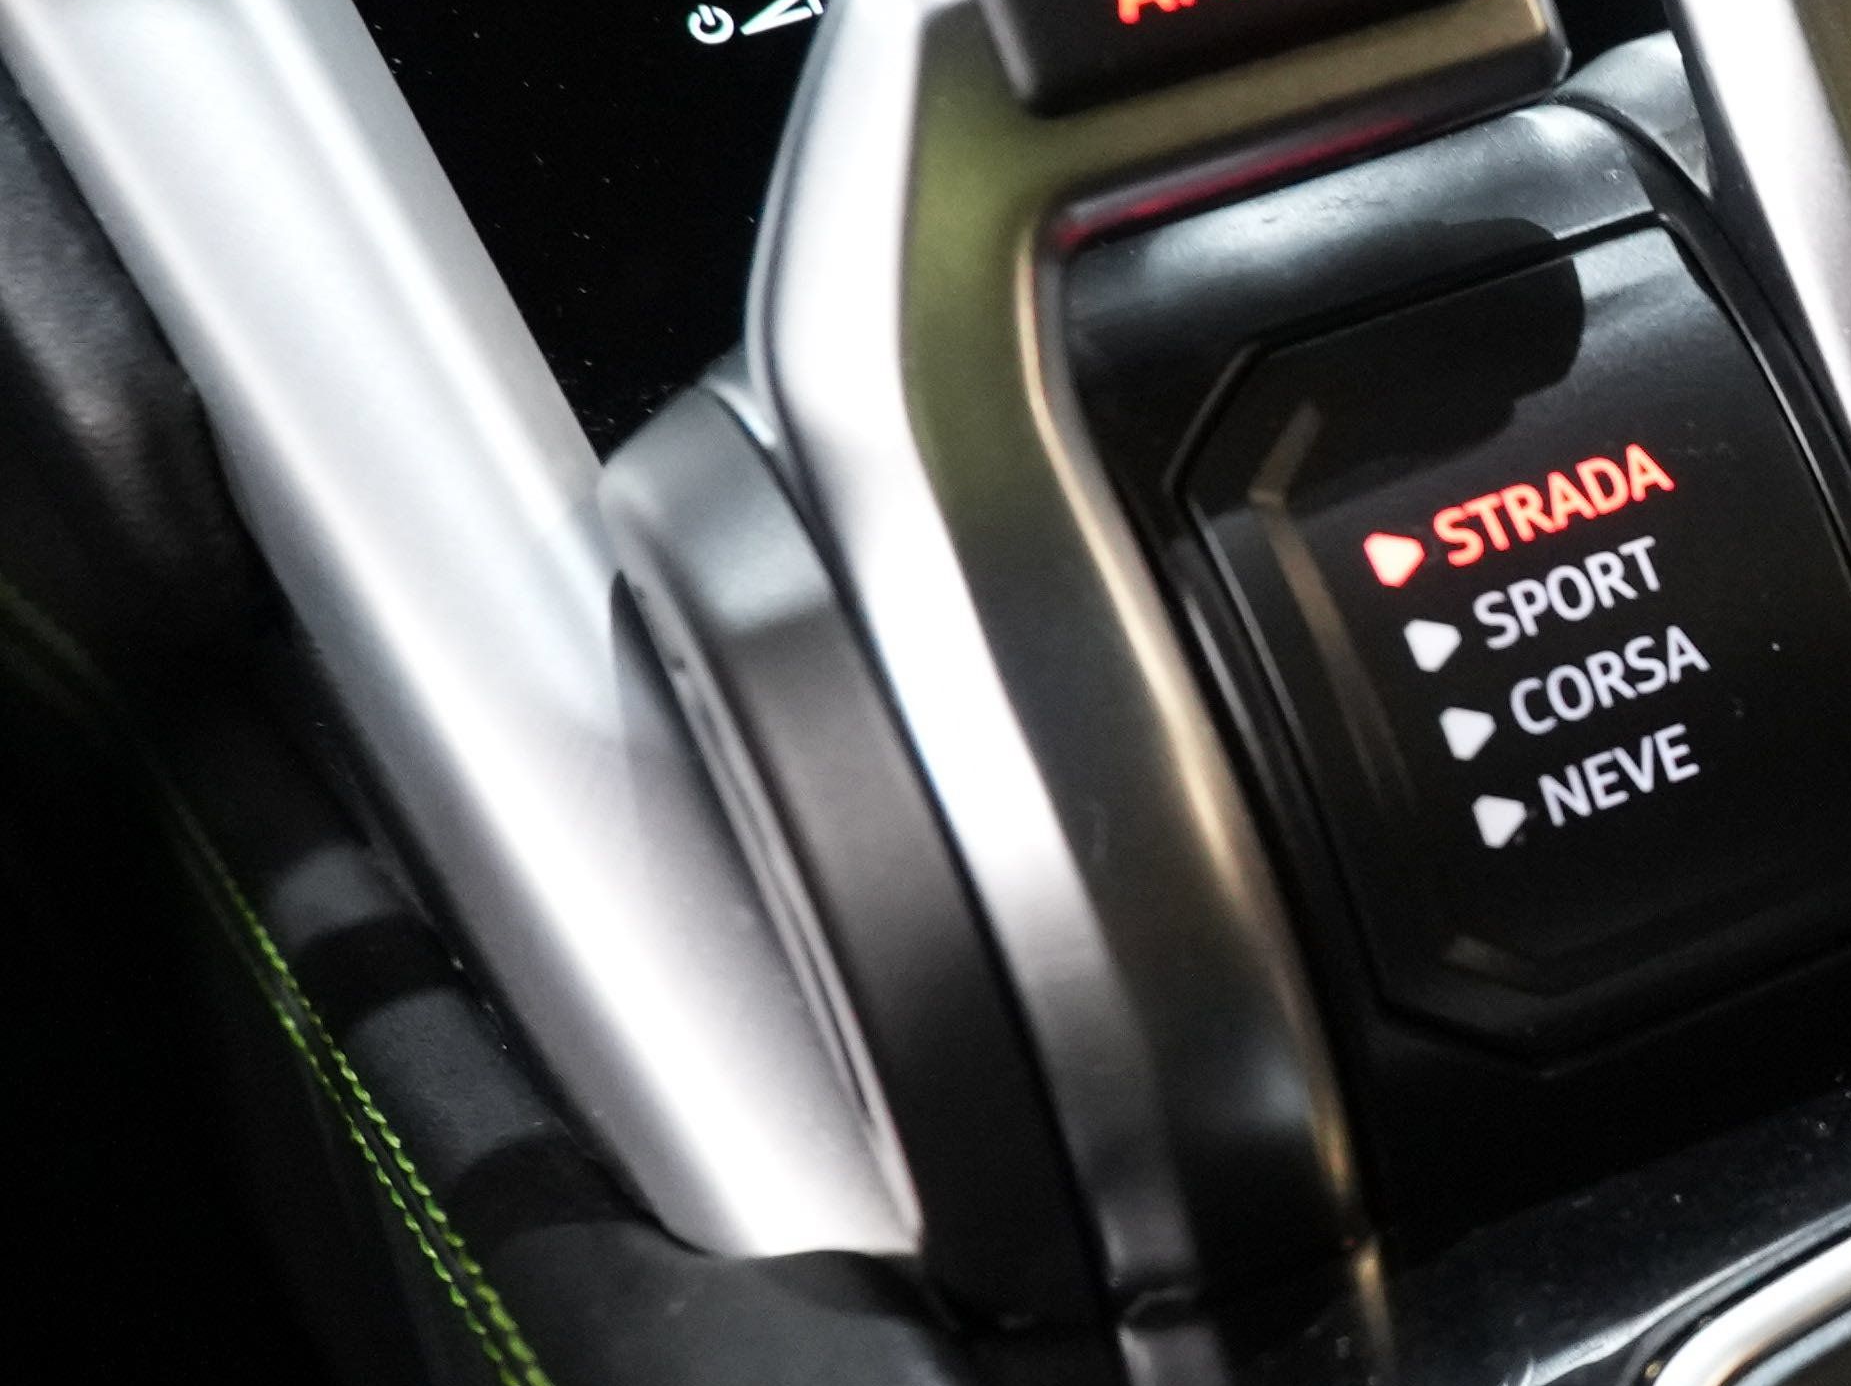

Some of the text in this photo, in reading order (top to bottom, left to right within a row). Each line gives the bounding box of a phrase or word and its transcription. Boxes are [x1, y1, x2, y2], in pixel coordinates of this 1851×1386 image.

[1432, 442, 1676, 568] STRADA
[1472, 535, 1661, 650] SPORT
[1509, 624, 1712, 735] CORSA
[1537, 723, 1701, 827] NEVE
